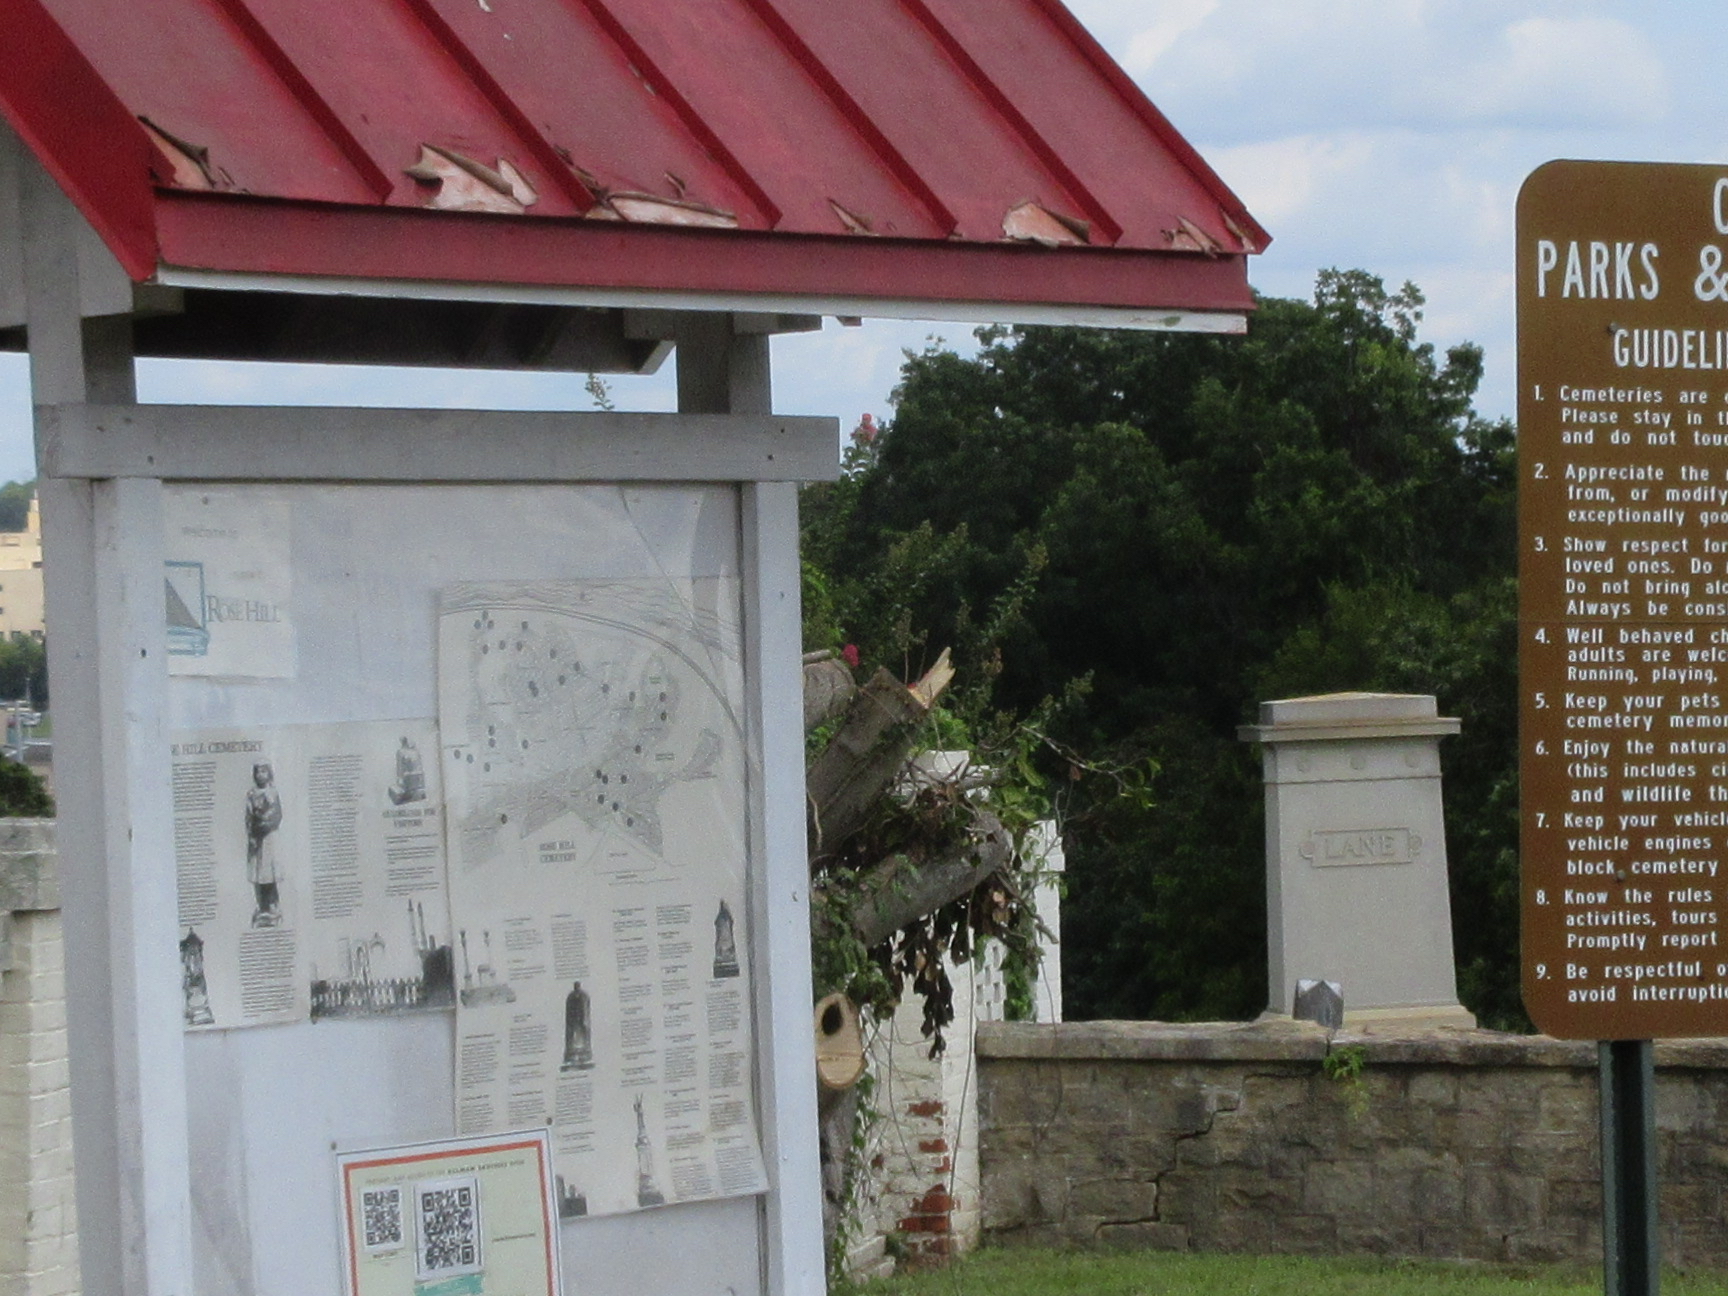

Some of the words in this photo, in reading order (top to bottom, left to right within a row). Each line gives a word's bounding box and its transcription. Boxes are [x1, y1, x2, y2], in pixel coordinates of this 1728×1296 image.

[1537, 239, 1659, 301] PARKS
[1534, 384, 1544, 401] 1.
[1559, 384, 1663, 403] Cemeteries
[1678, 390, 1708, 404] are
[1561, 406, 1618, 424] Please
[1632, 408, 1671, 429] stay
[1686, 410, 1702, 425] in
[1561, 428, 1594, 445] and
[1609, 428, 1631, 445] do
[1647, 429, 1676, 446] not
[1533, 462, 1549, 479] 2.
[1564, 462, 1664, 483] Appreciate
[1680, 465, 1709, 481] the
[1567, 483, 1615, 503] from,
[1630, 488, 1649, 501] or
[1665, 485, 1728, 506] modify
[1567, 507, 1685, 527] exceptionally
[1534, 627, 1550, 644] 4.
[1566, 627, 1603, 644] Well
[1618, 627, 1694, 644] behaved
[1567, 646, 1626, 663] adults
[1641, 649, 1671, 662] are
[1324, 835, 1396, 860] LANE
[1567, 835, 1629, 852] vehicle
[1644, 835, 1712, 854] engines
[1566, 858, 1615, 875] block
[1630, 857, 1718, 877] cemetery
[1535, 888, 1550, 905] 8.
[1563, 888, 1608, 905] Know
[1623, 887, 1653, 903] the
[1667, 887, 1712, 903] rules
[1535, 963, 1551, 980] 9.
[1565, 962, 1588, 980] Be
[1604, 960, 1701, 982] respectful
[1567, 985, 1616, 1003] avoid
